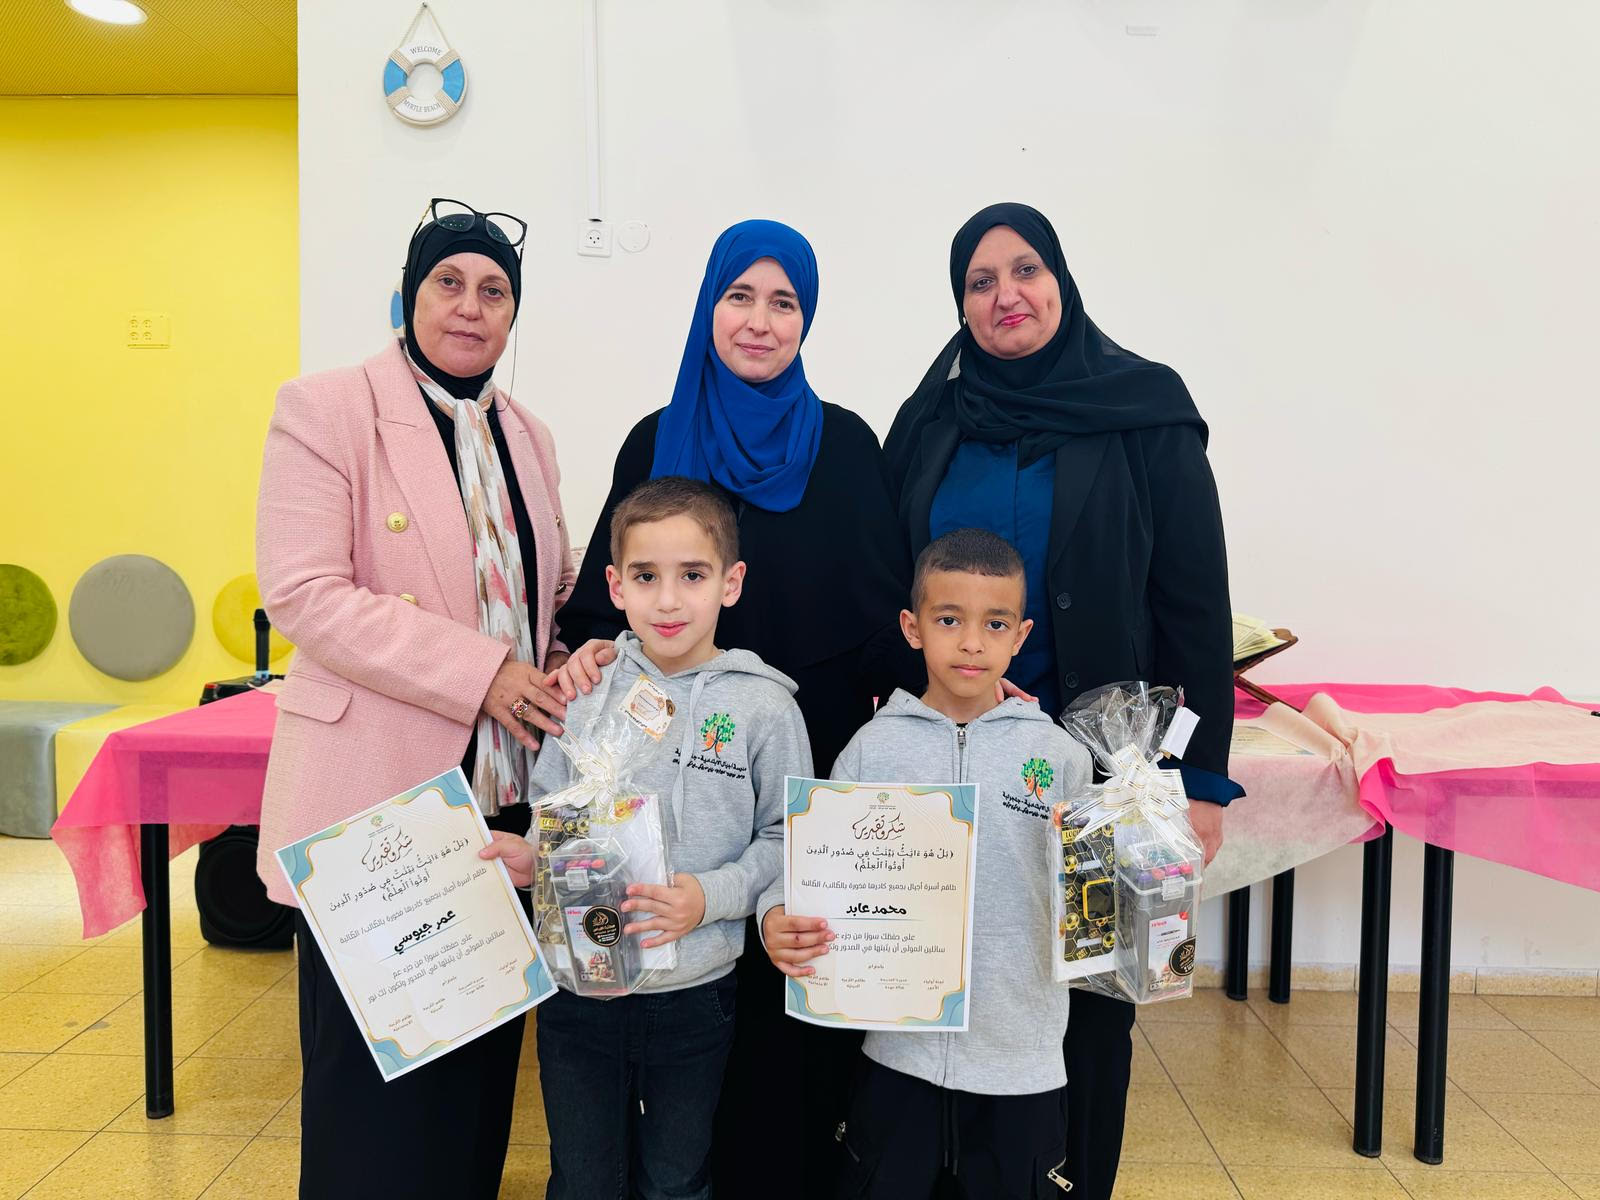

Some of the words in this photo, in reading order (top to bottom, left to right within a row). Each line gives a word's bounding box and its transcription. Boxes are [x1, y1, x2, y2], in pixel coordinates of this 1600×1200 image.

[410, 46, 442, 56] WELCOME
[403, 100, 422, 112] MYRTLE
[424, 103, 441, 112] BEACH
[846, 902, 870, 916] عابد
[872, 904, 907, 915] محمد
[436, 910, 456, 930] عمر
[394, 922, 432, 955] جيوسي
[461, 933, 473, 944] على
[852, 933, 862, 941] من
[902, 933, 916, 942] على
[862, 944, 872, 954] في
[414, 959, 424, 969] من
[428, 964, 438, 974] في
[392, 970, 402, 980] عم
